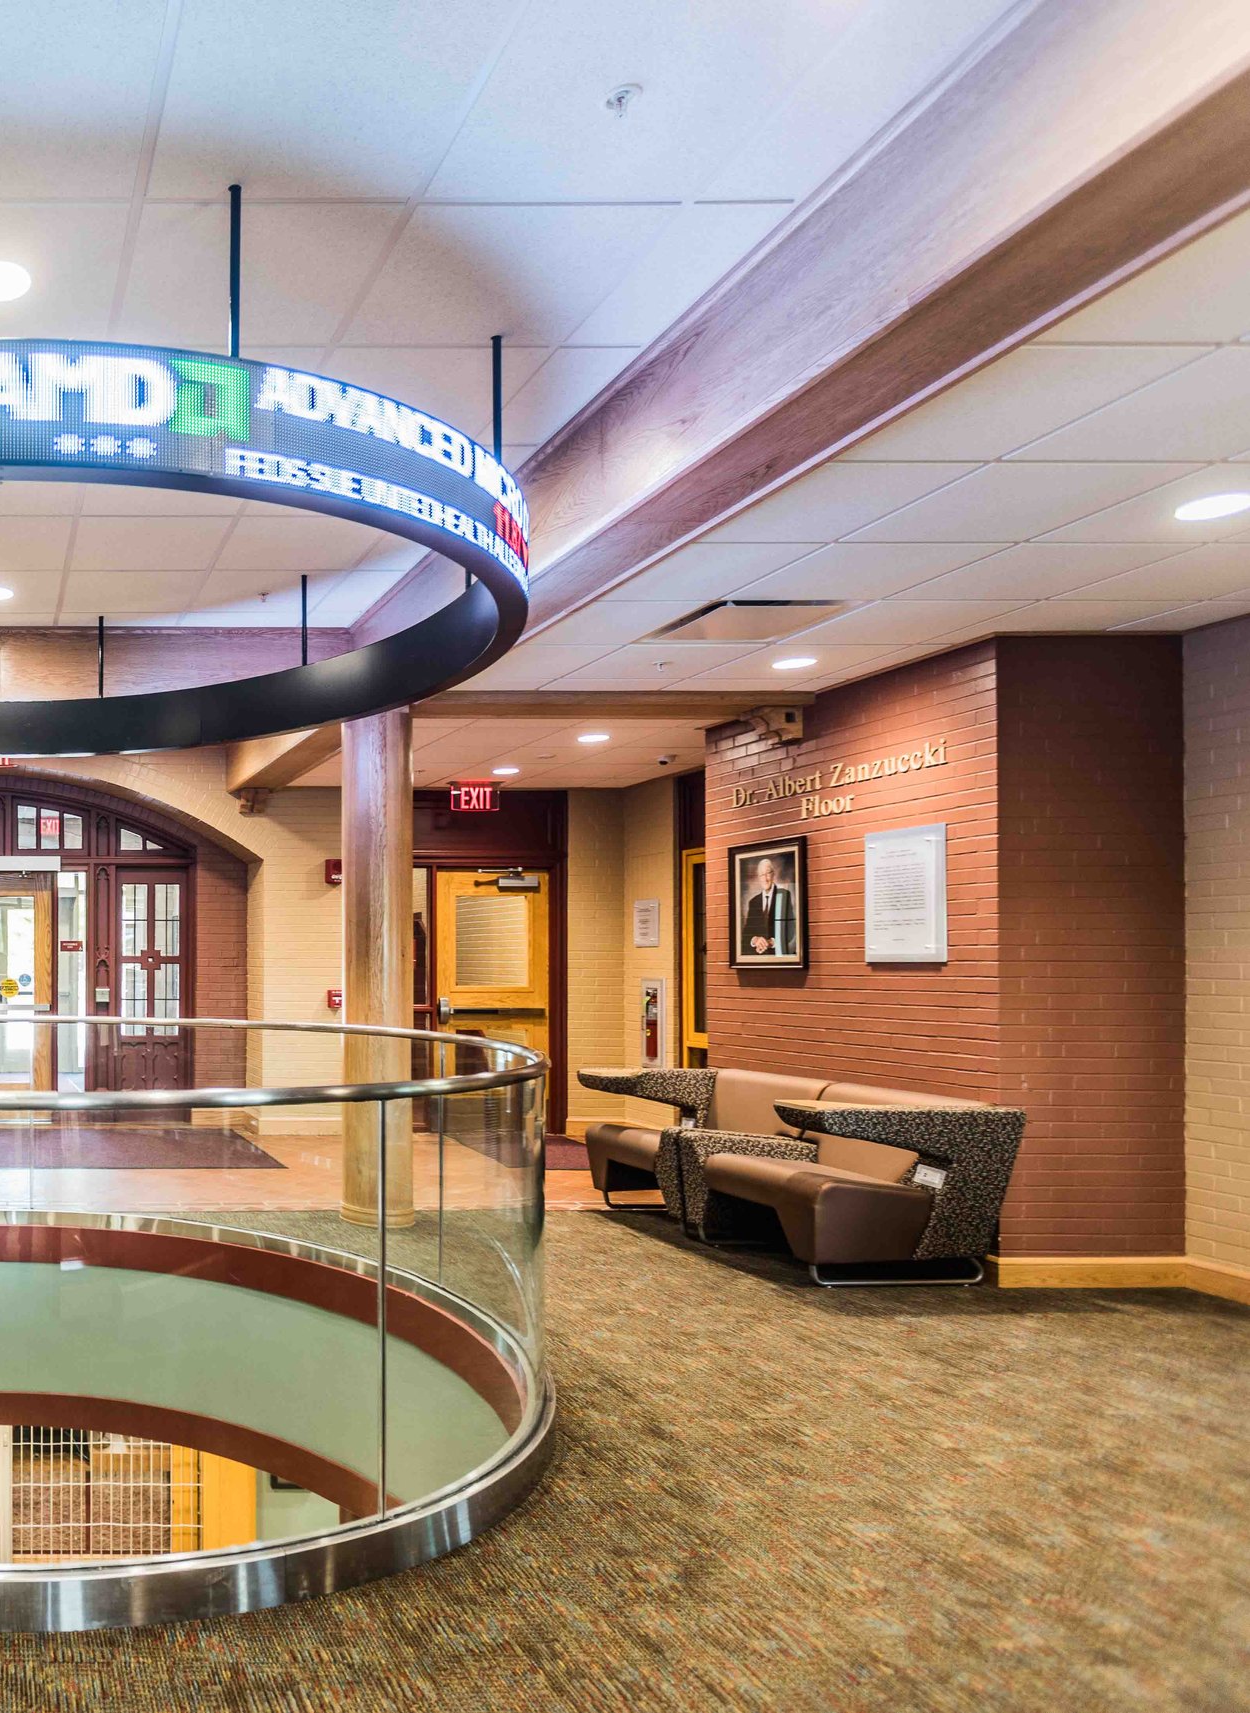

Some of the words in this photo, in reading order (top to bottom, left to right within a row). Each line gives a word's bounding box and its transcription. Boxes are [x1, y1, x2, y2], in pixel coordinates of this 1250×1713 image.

[255, 366, 475, 479] ADVANCED
[474, 443, 523, 530] MICRO
[224, 447, 306, 490] FEDS
[460, 787, 493, 810] EXIT
[731, 785, 758, 809] Dr.
[766, 770, 823, 801] Albert
[800, 793, 855, 820] Floor
[40, 818, 60, 835] EXIT
